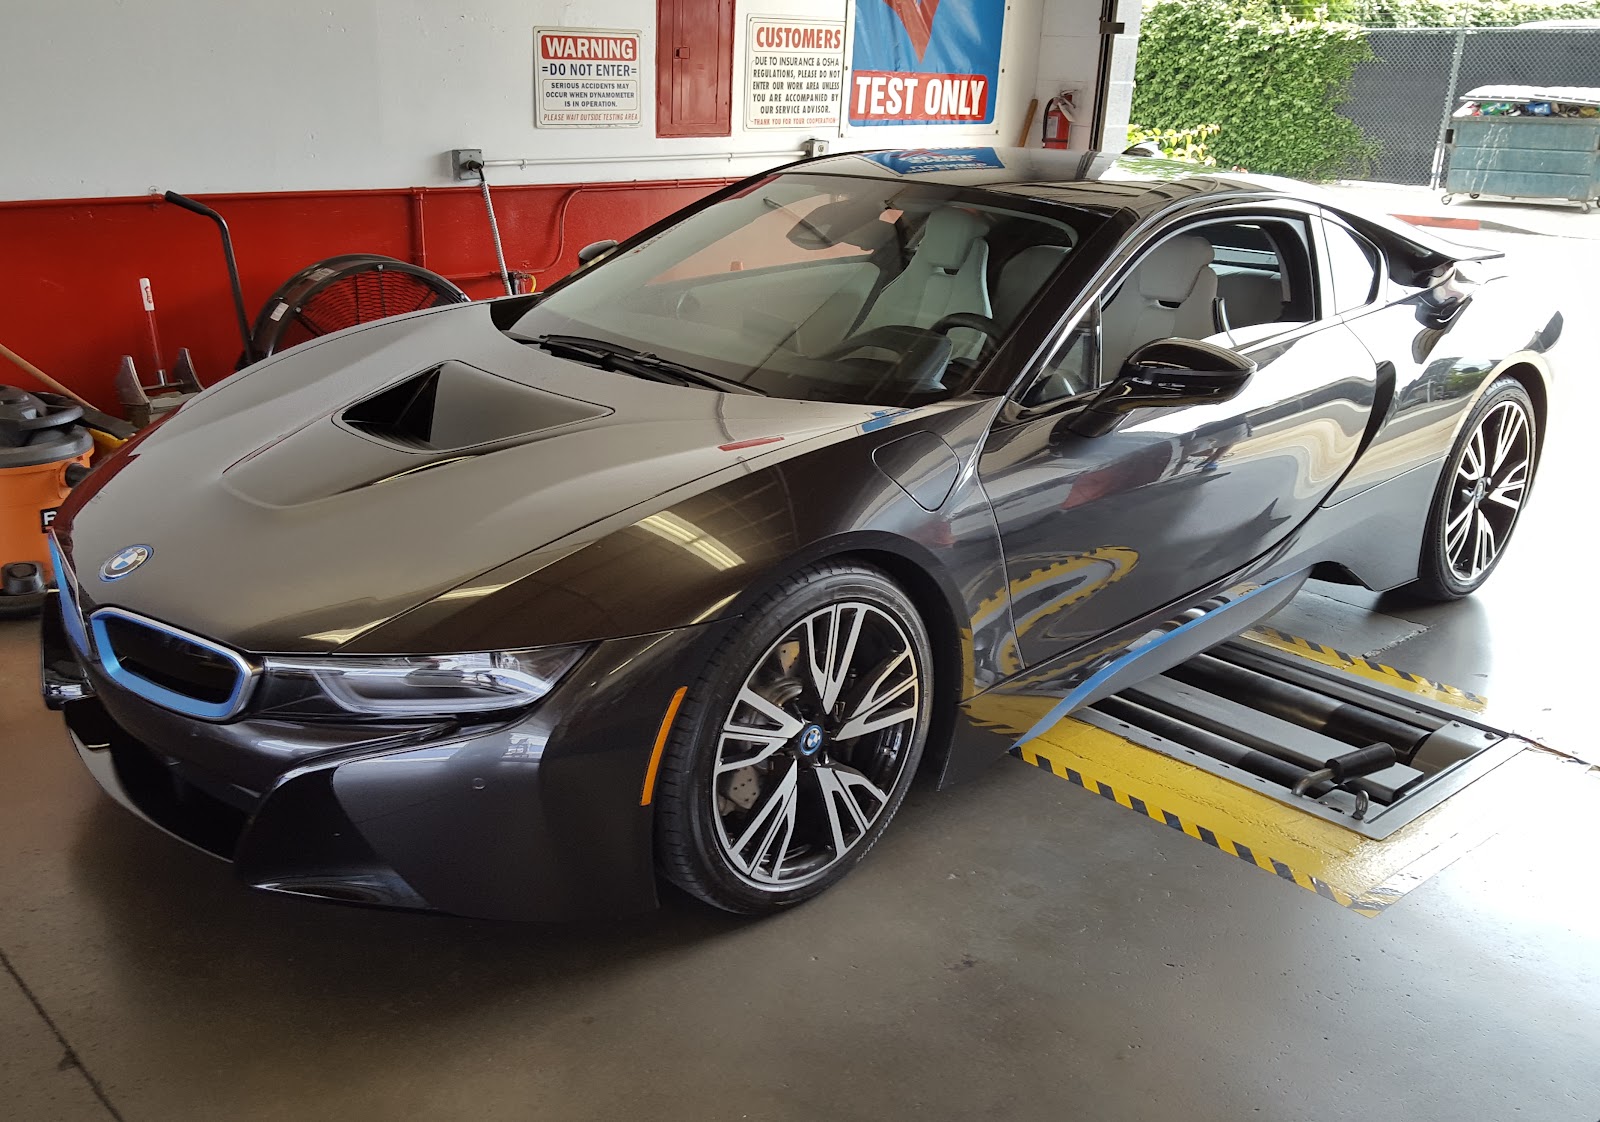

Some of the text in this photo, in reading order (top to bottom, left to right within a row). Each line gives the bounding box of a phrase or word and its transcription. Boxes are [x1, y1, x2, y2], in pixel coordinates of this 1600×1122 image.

[756, 26, 841, 49] CUSTOMERS
[545, 37, 633, 59] WARNING
[755, 56, 840, 66] DUE TO INSURANCE & OSHA
[550, 63, 630, 77] DO NOT ENTER
[753, 69, 840, 79] REGULATIONS, PLEASE DO NOT
[752, 81, 840, 90] ENTER OUR WORK AREA UNLESS
[752, 93, 839, 102] YOU ARE ACCOMPANIED BY
[856, 76, 985, 116] TEST ONLY
[760, 105, 831, 114] OUR SERVICE ADVISOR.
[543, 113, 638, 121] PLEASE WAIT OUTSIDE TESTING AREA
